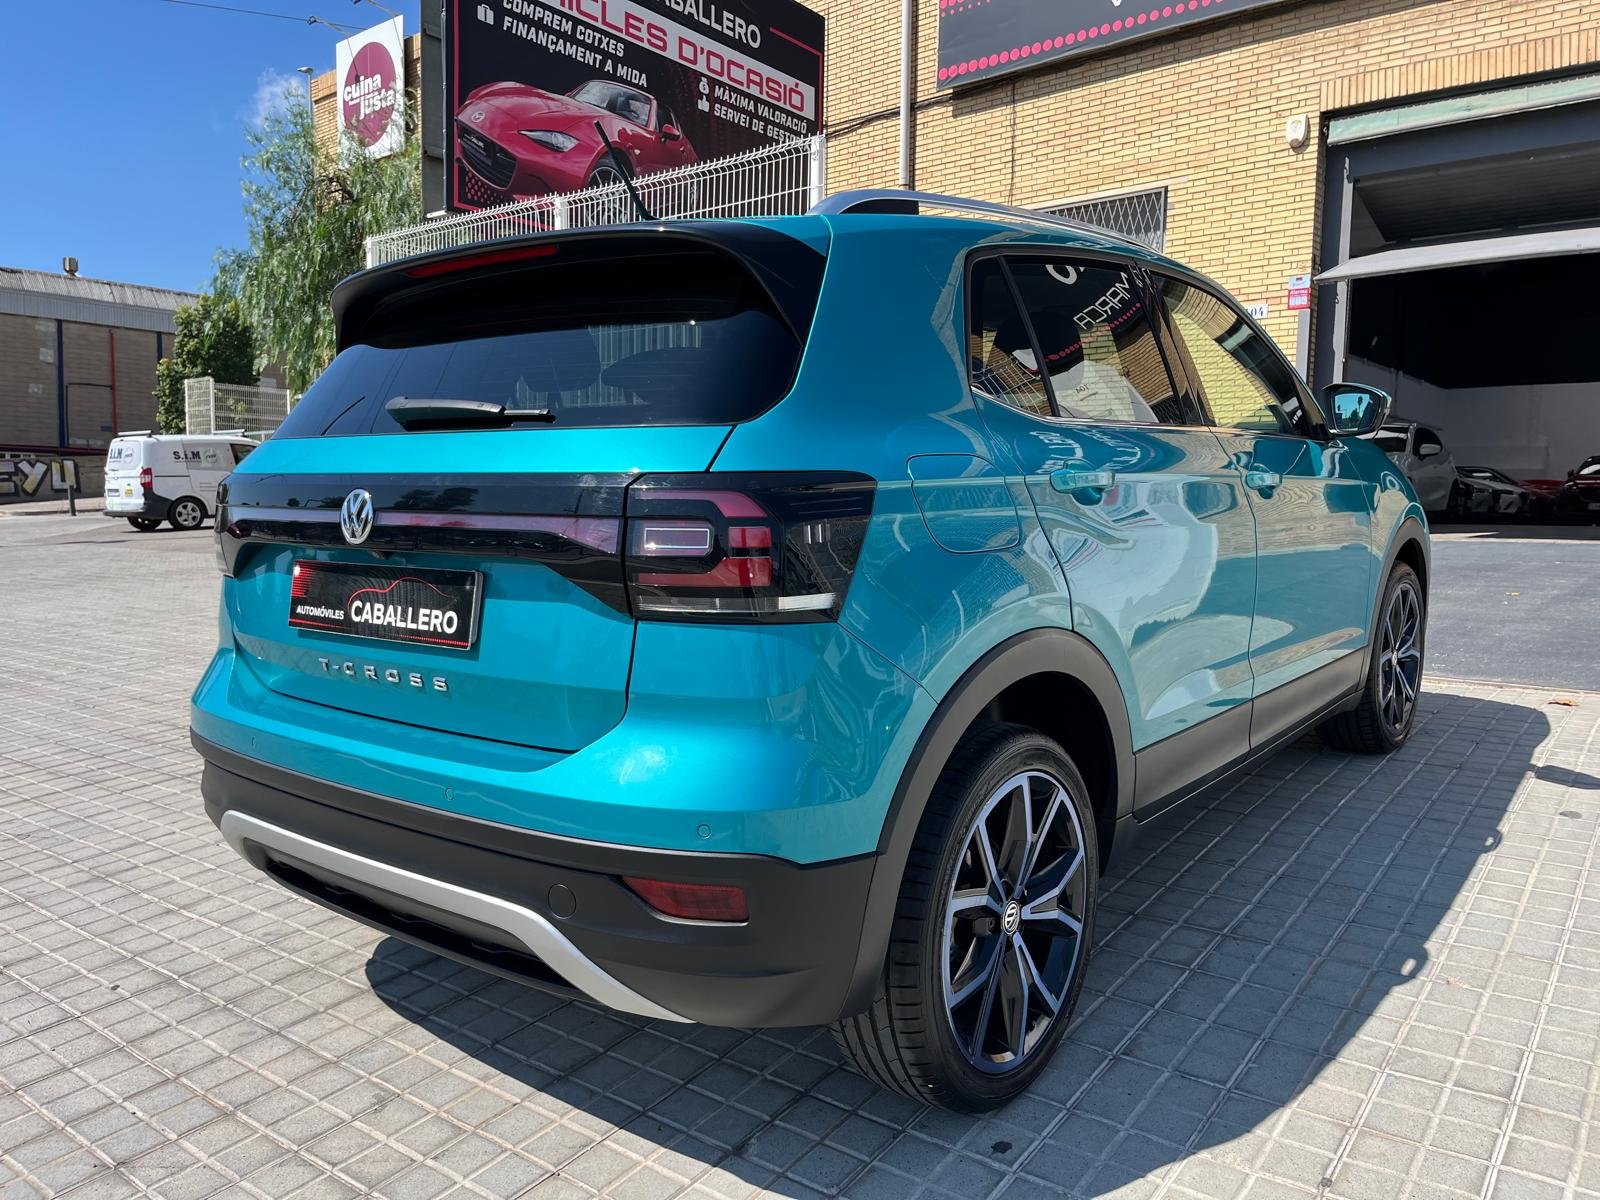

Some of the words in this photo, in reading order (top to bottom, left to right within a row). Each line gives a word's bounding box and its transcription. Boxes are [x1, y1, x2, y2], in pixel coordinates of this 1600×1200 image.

[503, 0, 573, 35] COMPREM
[576, 25, 625, 57] COTXES
[503, 15, 602, 68] FINANÇAMENT
[604, 59, 613, 74] A
[617, 63, 647, 88] MIDA
[344, 74, 381, 102] cuina
[678, 36, 804, 113] D'OCASIÓ
[713, 103, 750, 128] SERVEI
[752, 118, 765, 134] DE
[714, 85, 754, 113] MÀXIMA
[757, 103, 807, 134] VALORACIÓ
[296, 604, 345, 620] AUTOMÓVILES
[351, 600, 458, 634] CABALLERO
[318, 658, 448, 692] T-CROSS
